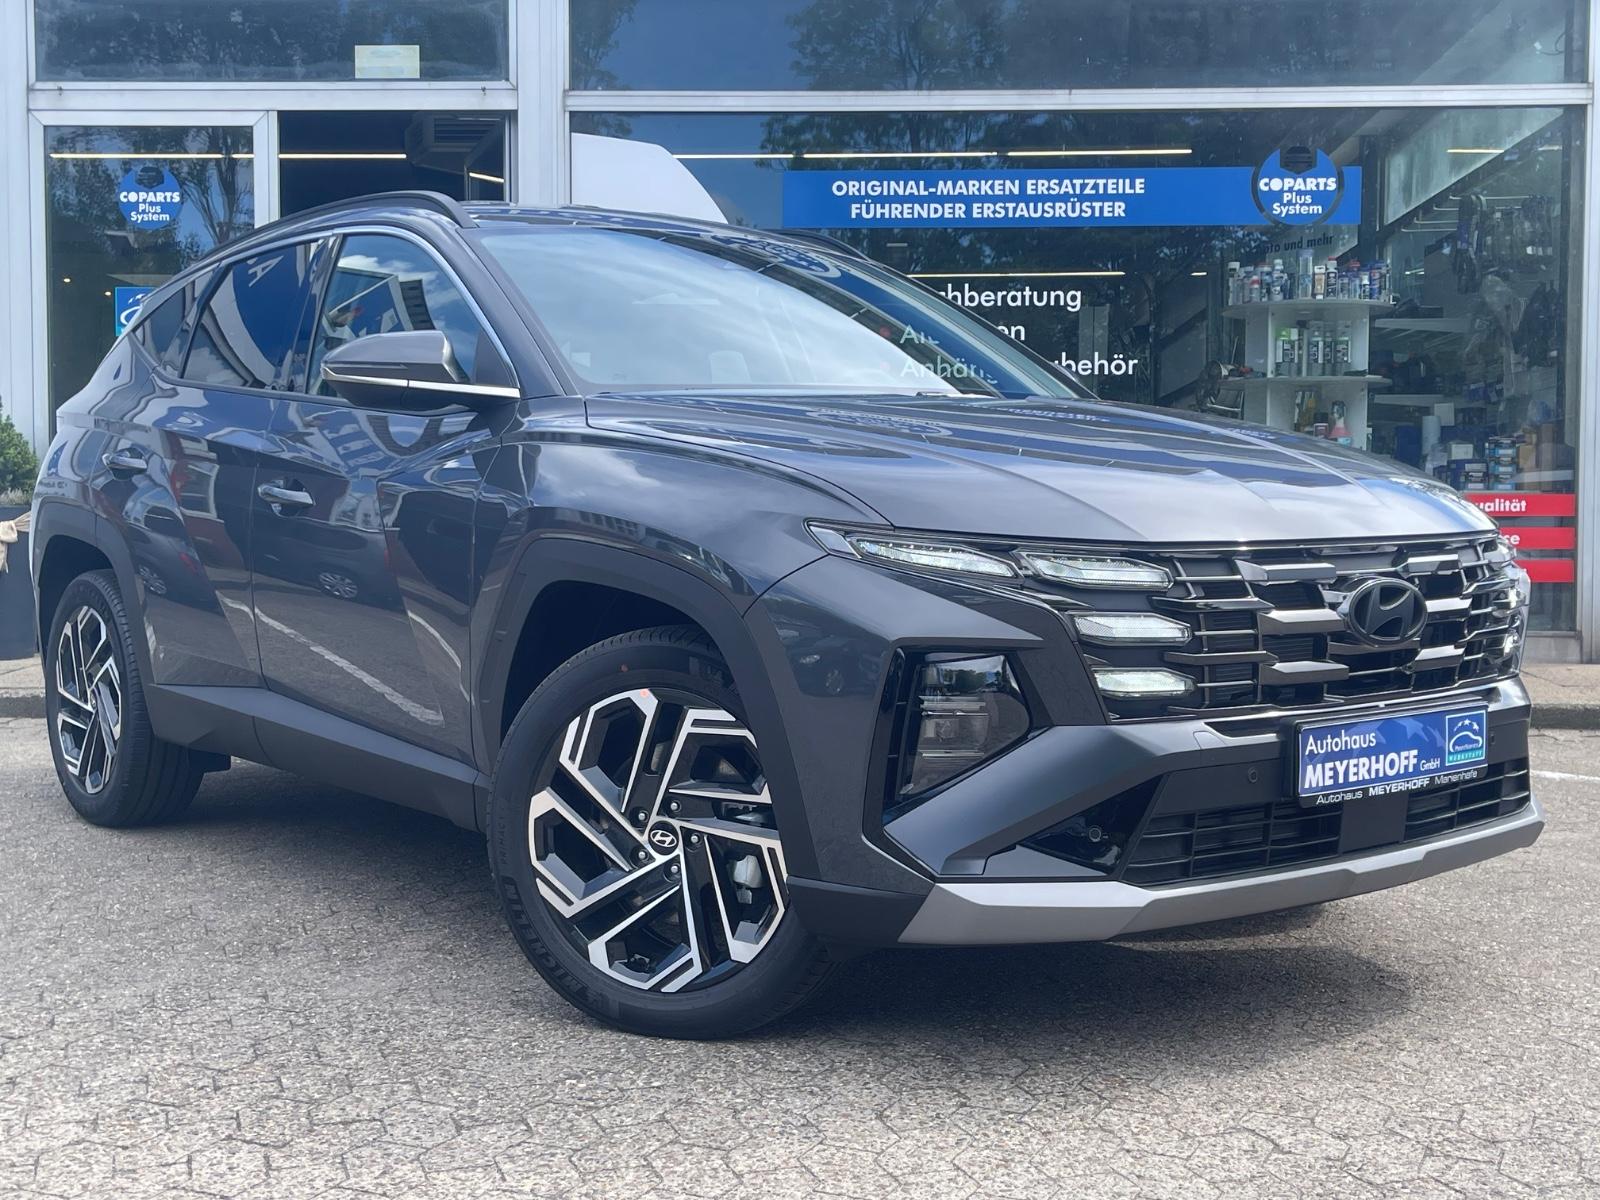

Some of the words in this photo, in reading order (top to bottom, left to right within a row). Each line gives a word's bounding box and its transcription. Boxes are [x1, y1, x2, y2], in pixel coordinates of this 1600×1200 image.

[831, 179, 1020, 196] ORIGINAL-MARKEN
[1026, 178, 1145, 195] ERSATZTEILE
[1259, 177, 1337, 191] COPARTS
[120, 191, 180, 202] COPARTS
[1283, 192, 1312, 204] Plus
[139, 203, 161, 213] Plus
[851, 199, 966, 219] FÜHRENDER
[972, 198, 1126, 218] ERSTAUSRÜSTER
[1272, 203, 1323, 217] System
[130, 212, 170, 223] System
[1284, 237, 1303, 251] und
[1306, 232, 1334, 248] mehr
[939, 284, 1082, 312] hberatung
[1055, 352, 1138, 376] behör
[1305, 730, 1376, 755] Autohaus
[1304, 750, 1418, 788] MEYERHOFF
[1420, 758, 1440, 771] GmbH
[1316, 789, 1363, 805] Autohaus
[1369, 778, 1430, 796] MEYERHOFF
